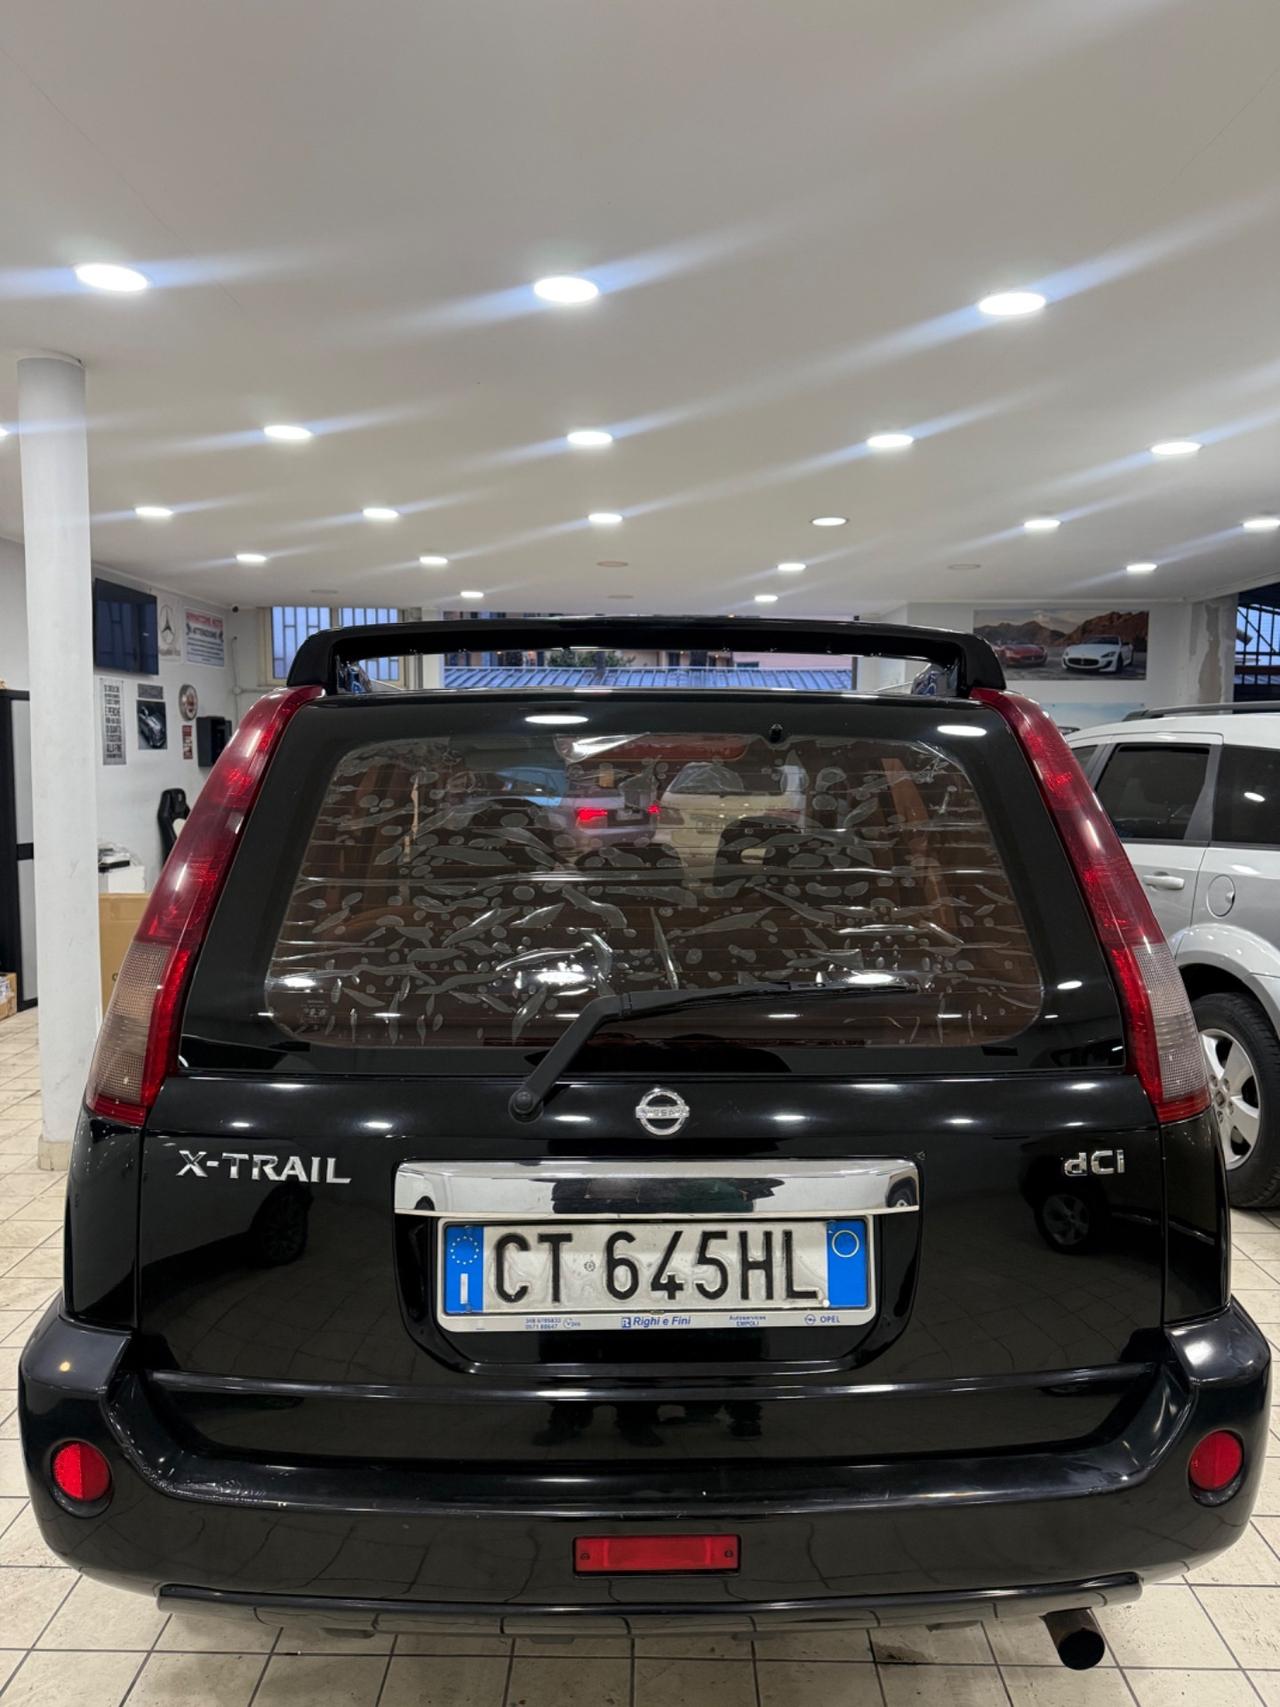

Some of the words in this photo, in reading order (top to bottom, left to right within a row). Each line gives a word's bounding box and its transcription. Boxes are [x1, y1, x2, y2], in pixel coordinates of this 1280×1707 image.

[175, 1149, 352, 1184] X-TRAIL
[495, 1232, 573, 1304] CT
[605, 1229, 819, 1304] 645HL
[633, 1316, 660, 1328] Righi
[671, 1316, 692, 1326] Fini
[819, 1314, 841, 1324] OPEL
